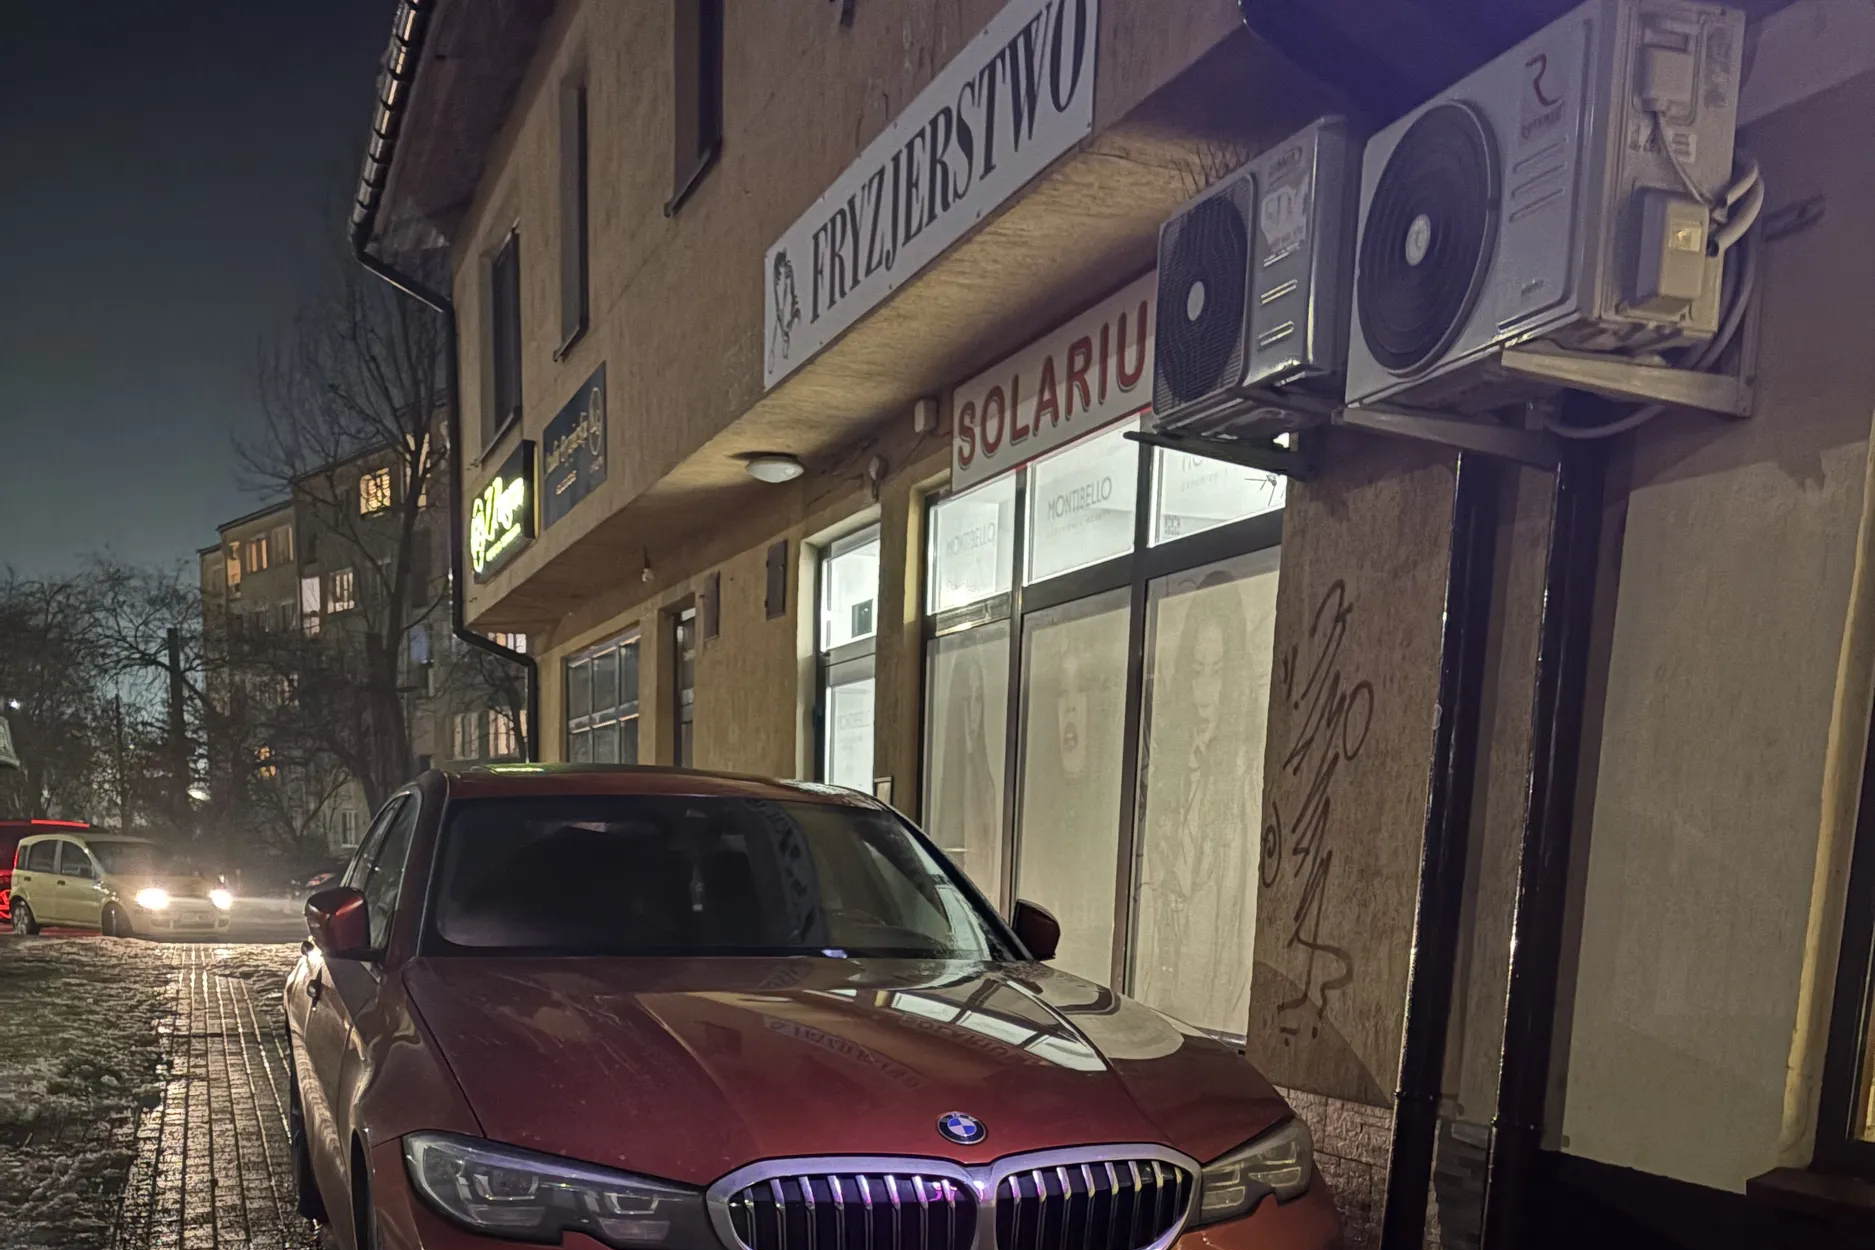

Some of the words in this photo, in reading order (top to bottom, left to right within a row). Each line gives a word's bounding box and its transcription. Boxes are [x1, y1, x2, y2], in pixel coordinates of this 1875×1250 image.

[810, 0, 1087, 324] FRYZJERSTWO
[957, 300, 1149, 470] SOLARIU
[1047, 475, 1113, 521] MONTIBELLO
